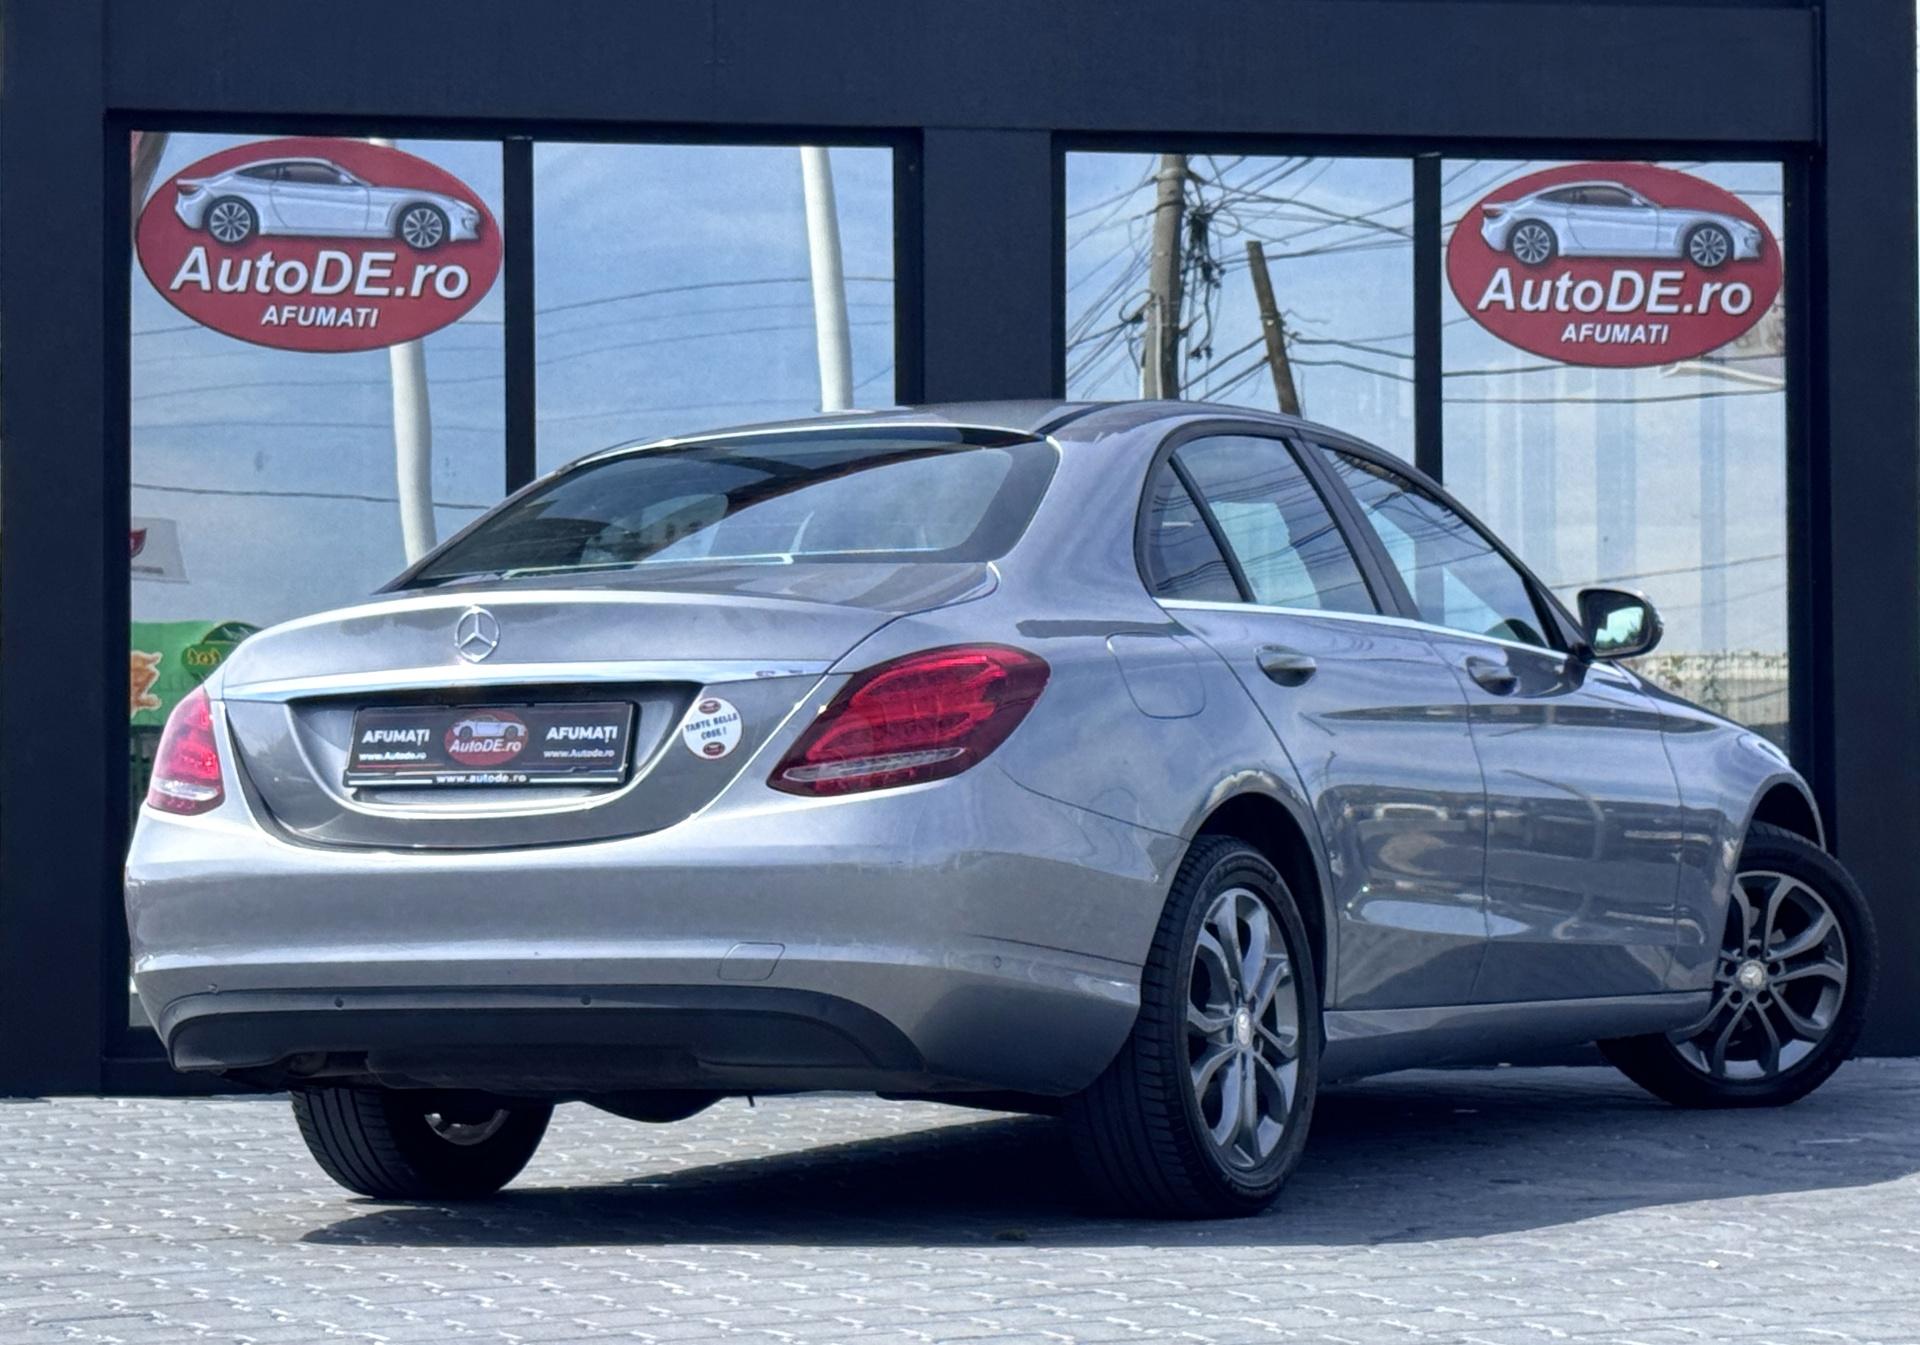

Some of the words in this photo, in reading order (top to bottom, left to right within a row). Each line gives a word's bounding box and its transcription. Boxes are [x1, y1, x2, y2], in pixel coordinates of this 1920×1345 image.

[170, 246, 470, 299] AutoDE.ro
[1477, 267, 1752, 315] AutoDE.ro
[261, 305, 380, 328] AFUMATI
[1561, 323, 1670, 344] AFUMATI
[448, 738, 522, 753] AutoDE.ro
[436, 773, 527, 784] www.autode.ro
